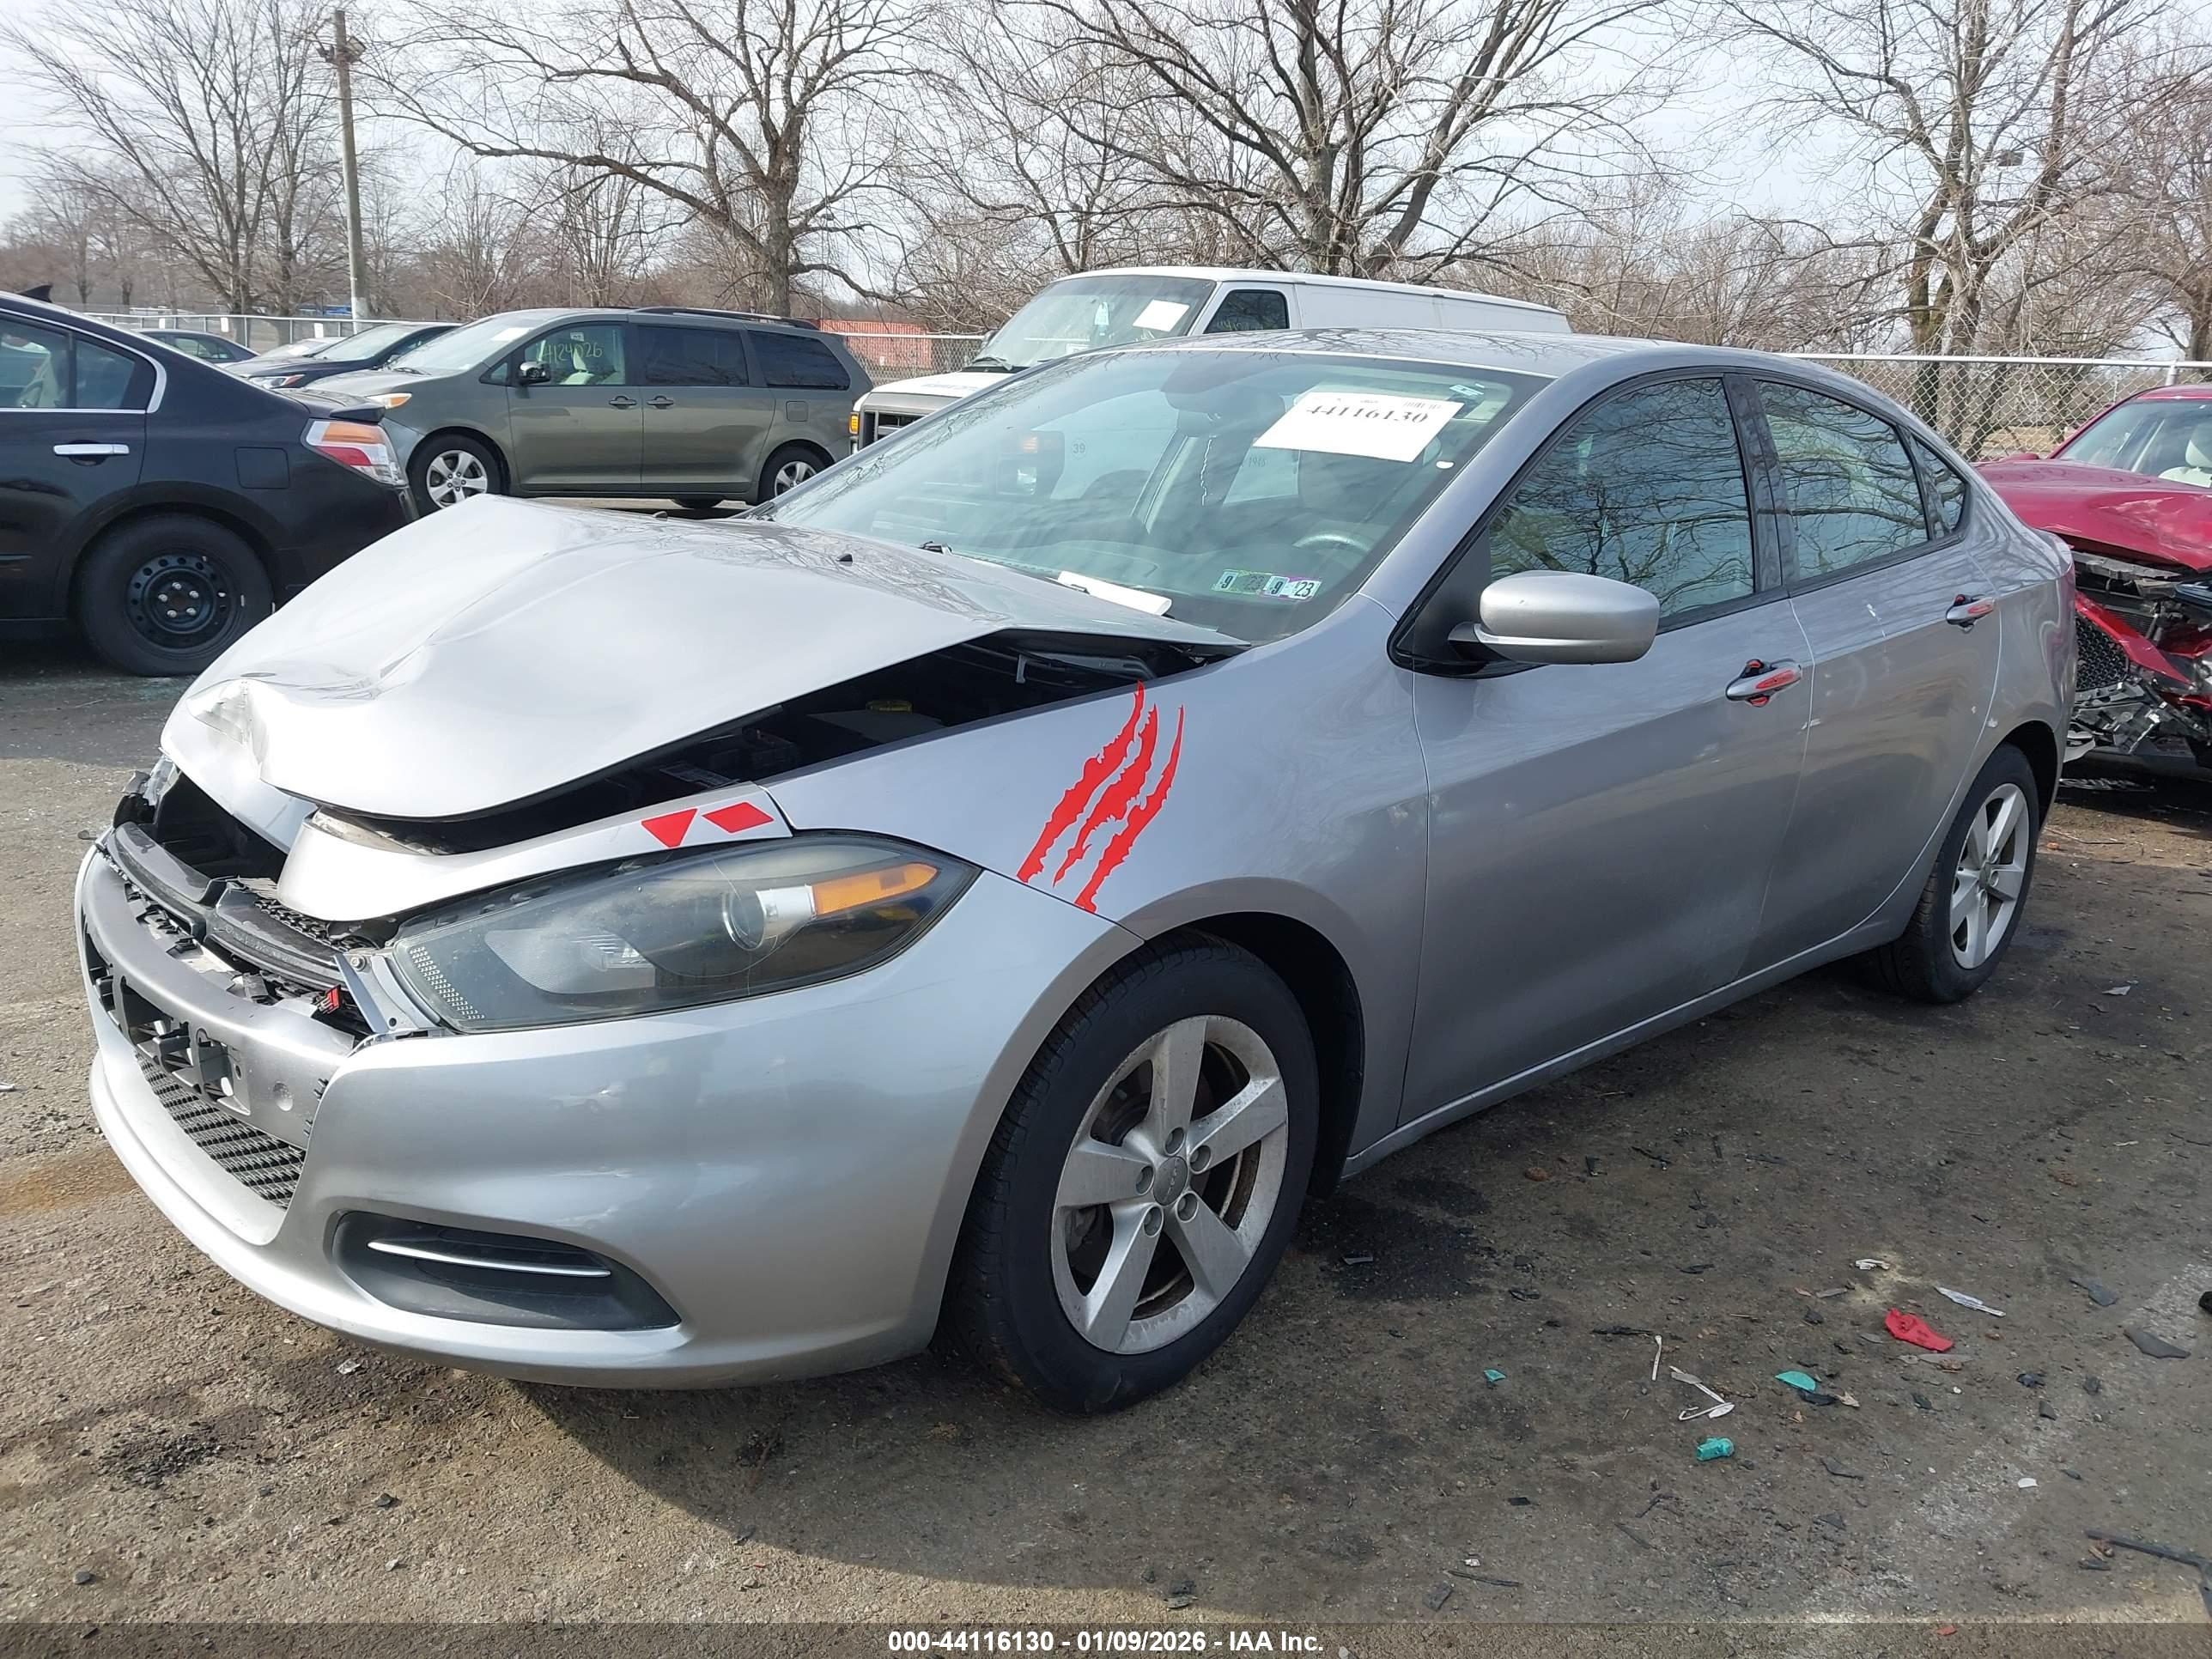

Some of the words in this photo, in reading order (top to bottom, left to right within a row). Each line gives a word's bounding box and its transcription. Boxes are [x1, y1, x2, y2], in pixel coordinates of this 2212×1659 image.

[1305, 405, 1429, 423] 44116130
[1073, 443, 1085, 454] 39
[1222, 575, 1234, 589] 9
[1271, 580, 1284, 595] 9
[1295, 581, 1315, 598] 23
